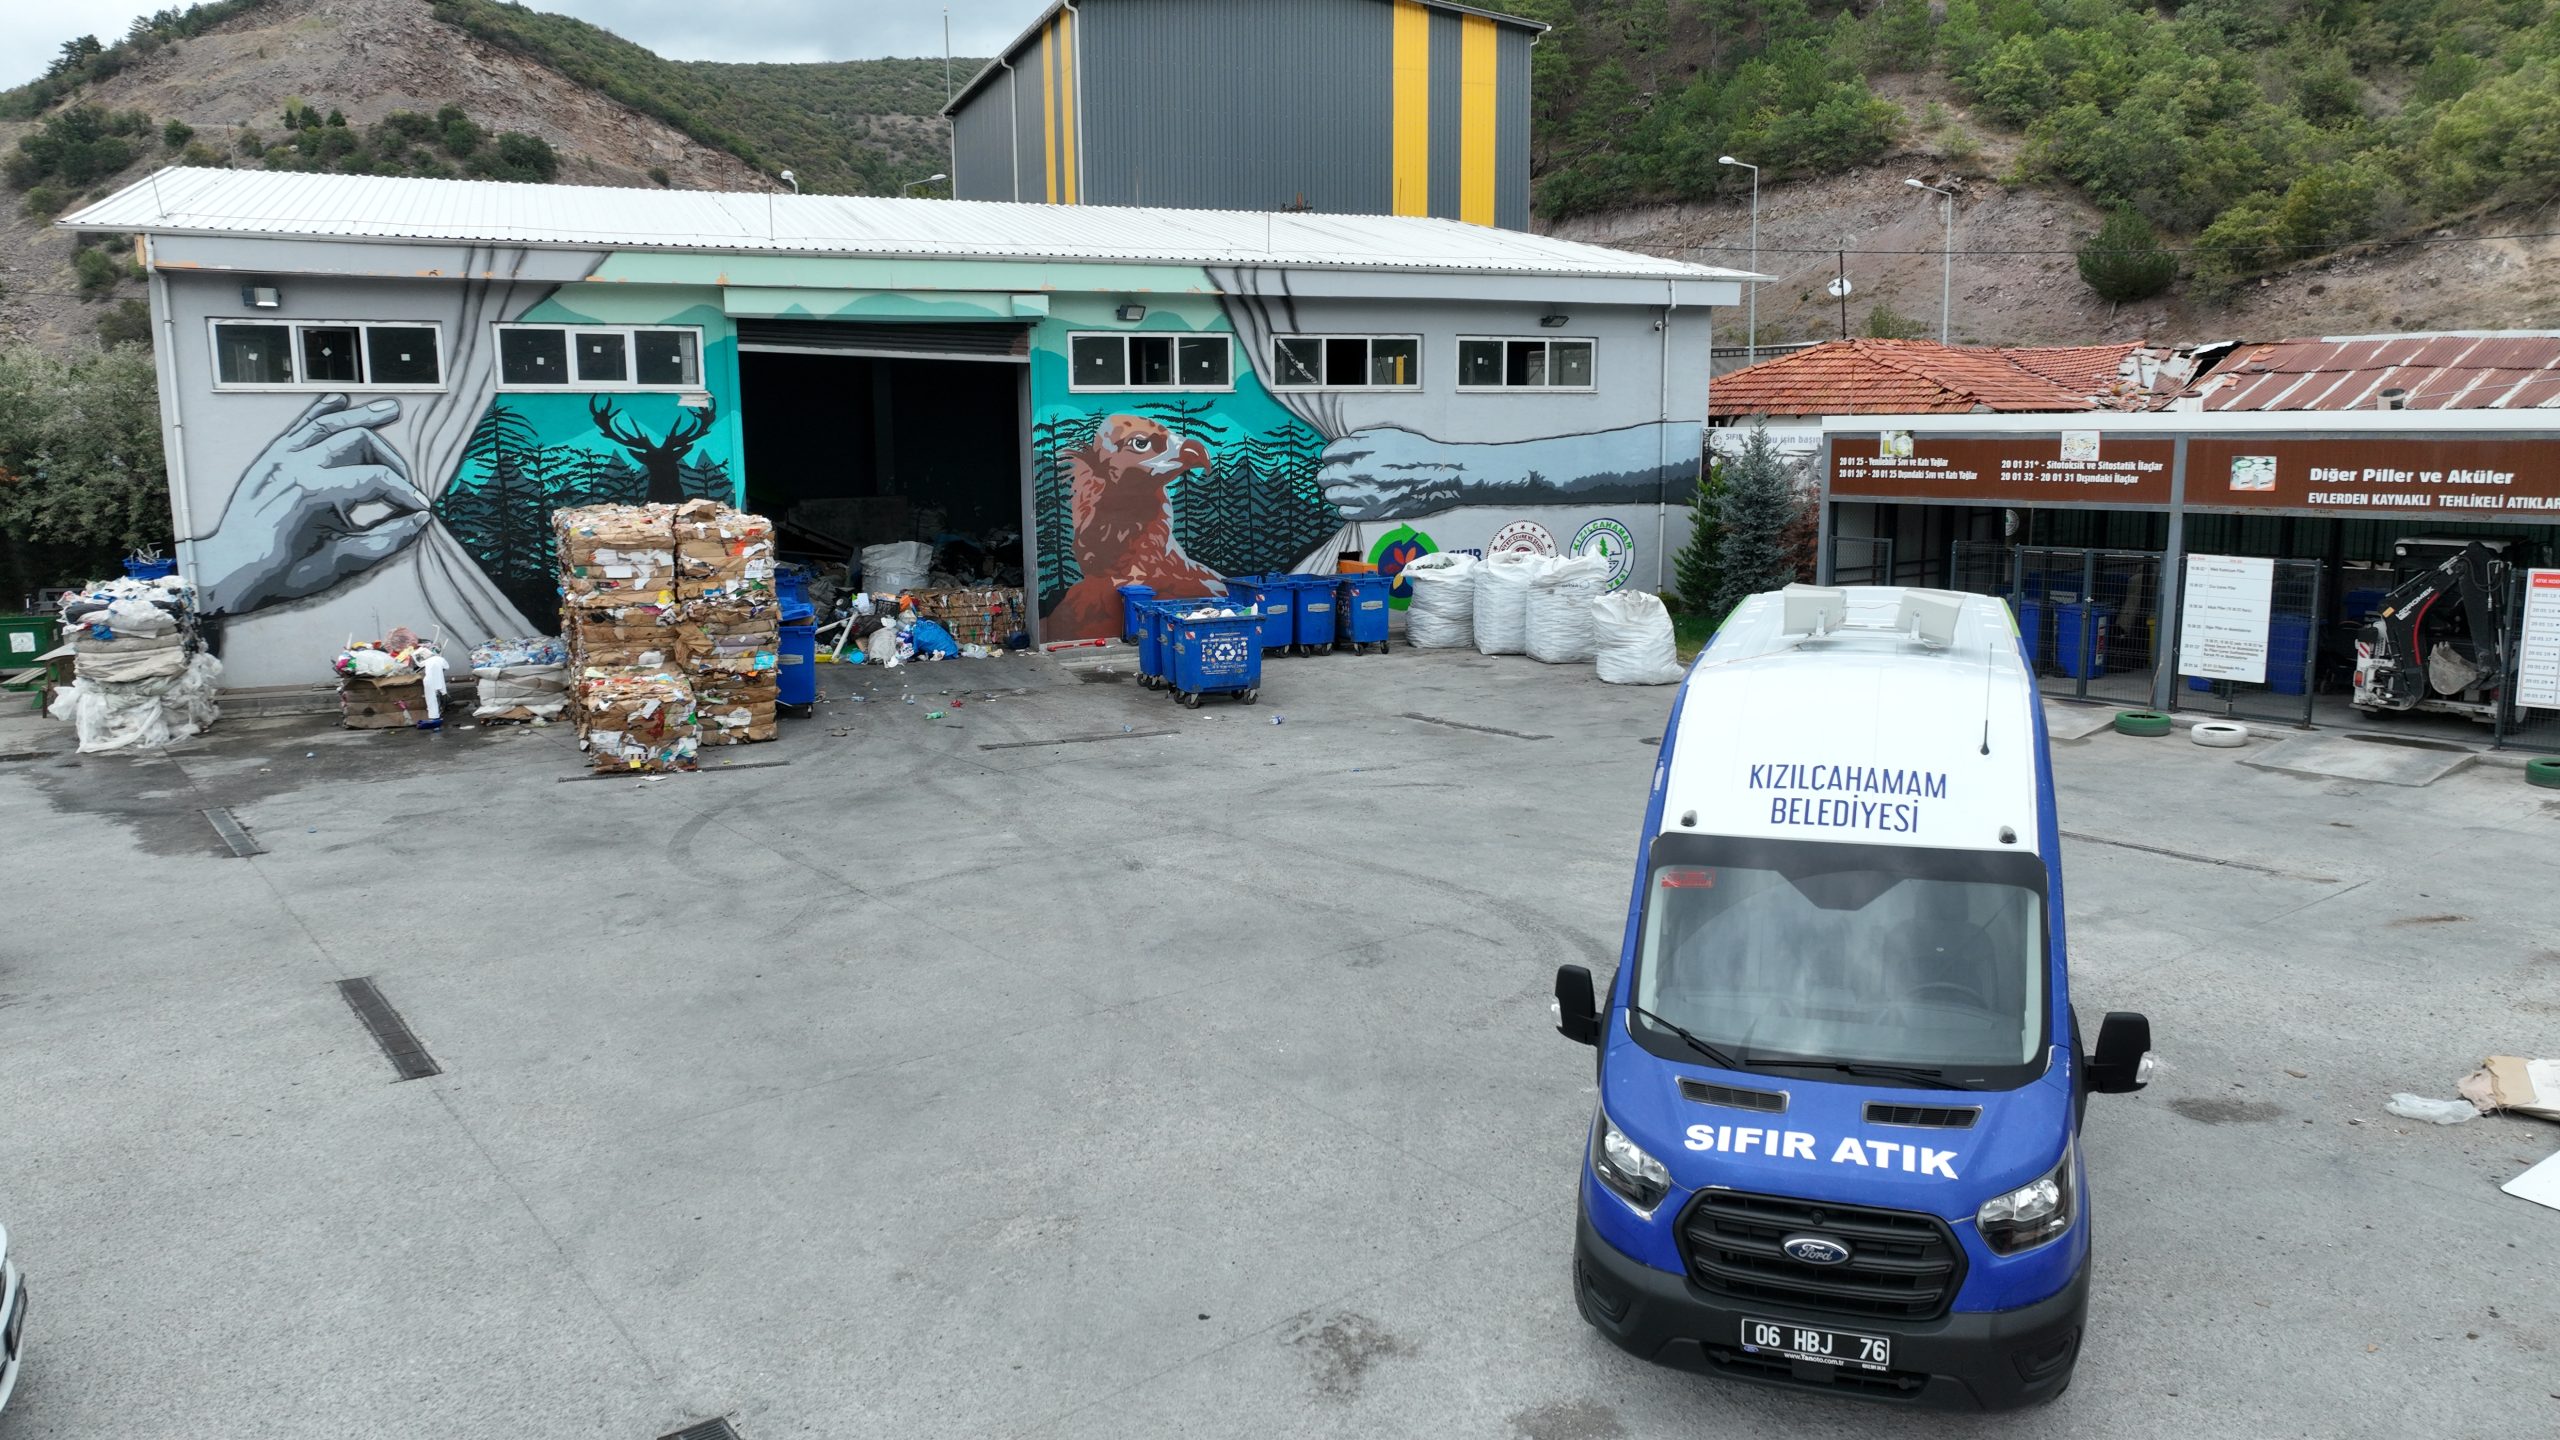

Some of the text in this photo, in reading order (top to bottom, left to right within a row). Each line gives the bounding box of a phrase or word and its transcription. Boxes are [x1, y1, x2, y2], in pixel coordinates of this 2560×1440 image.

[1856, 458, 1864, 466] 25
[2001, 460, 2011, 468] 20
[2012, 460, 2022, 468] 01
[2047, 460, 2085, 470] Sitotoksik
[2098, 461, 2136, 470] Sitostatik
[2138, 461, 2163, 472] İlaçlar
[1848, 470, 1854, 478] 01
[1872, 470, 1880, 478] 20
[1880, 470, 1888, 478] 01
[1889, 470, 1897, 478] 25
[2001, 472, 2011, 481] 20
[2012, 473, 2021, 481] 01
[2024, 473, 2034, 481] 32
[2041, 473, 2051, 482] 20
[2052, 474, 2062, 482] 01
[2064, 474, 2074, 482] 31
[2076, 474, 2112, 484] Dışındaki
[2114, 473, 2139, 485] İlaçlar
[2310, 467, 2514, 485] Diğer Piller ve Aküler
[2308, 492, 2560, 509] EVLERDEN KAYNAKLI TEHLİKELİ ATIKLAR
[1749, 764, 1947, 799] KIZILCAHAMAM
[1770, 794, 1919, 833] BELEDİYESİ
[1684, 1124, 1959, 1180] SIFIR ATIK
[1798, 1243, 1833, 1261] Ford
[1755, 1324, 1886, 1362] 06 HBJ 76
